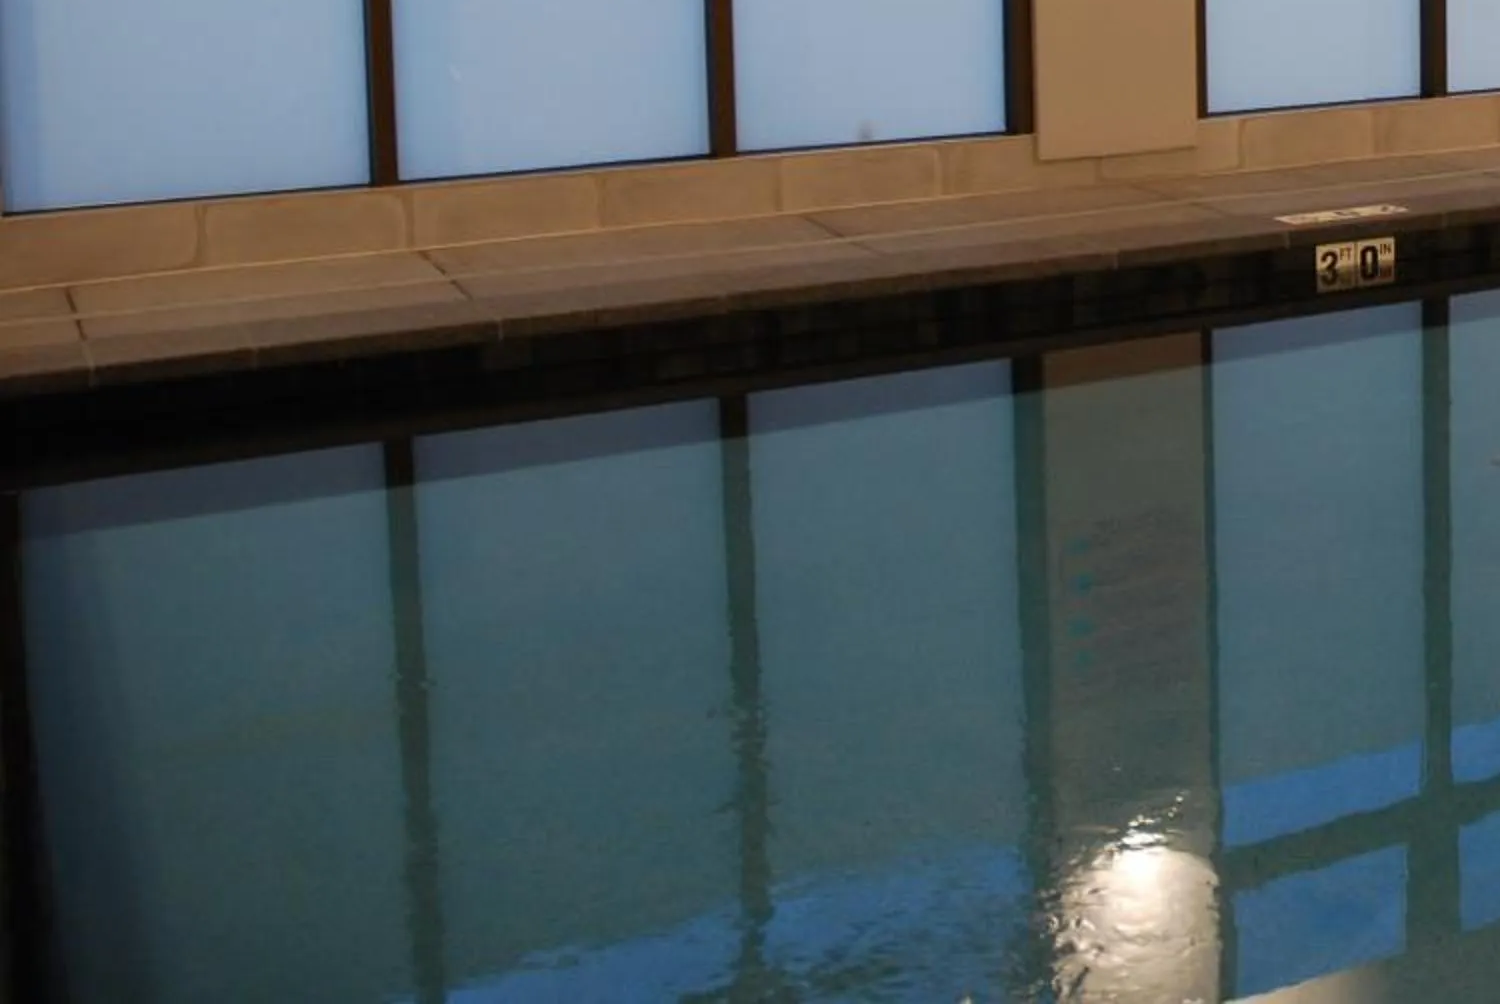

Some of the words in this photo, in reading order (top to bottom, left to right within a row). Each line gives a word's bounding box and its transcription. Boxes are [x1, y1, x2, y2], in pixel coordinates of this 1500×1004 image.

[1340, 248, 1353, 260] FT
[1360, 246, 1379, 280] 0
[1380, 243, 1392, 256] IN
